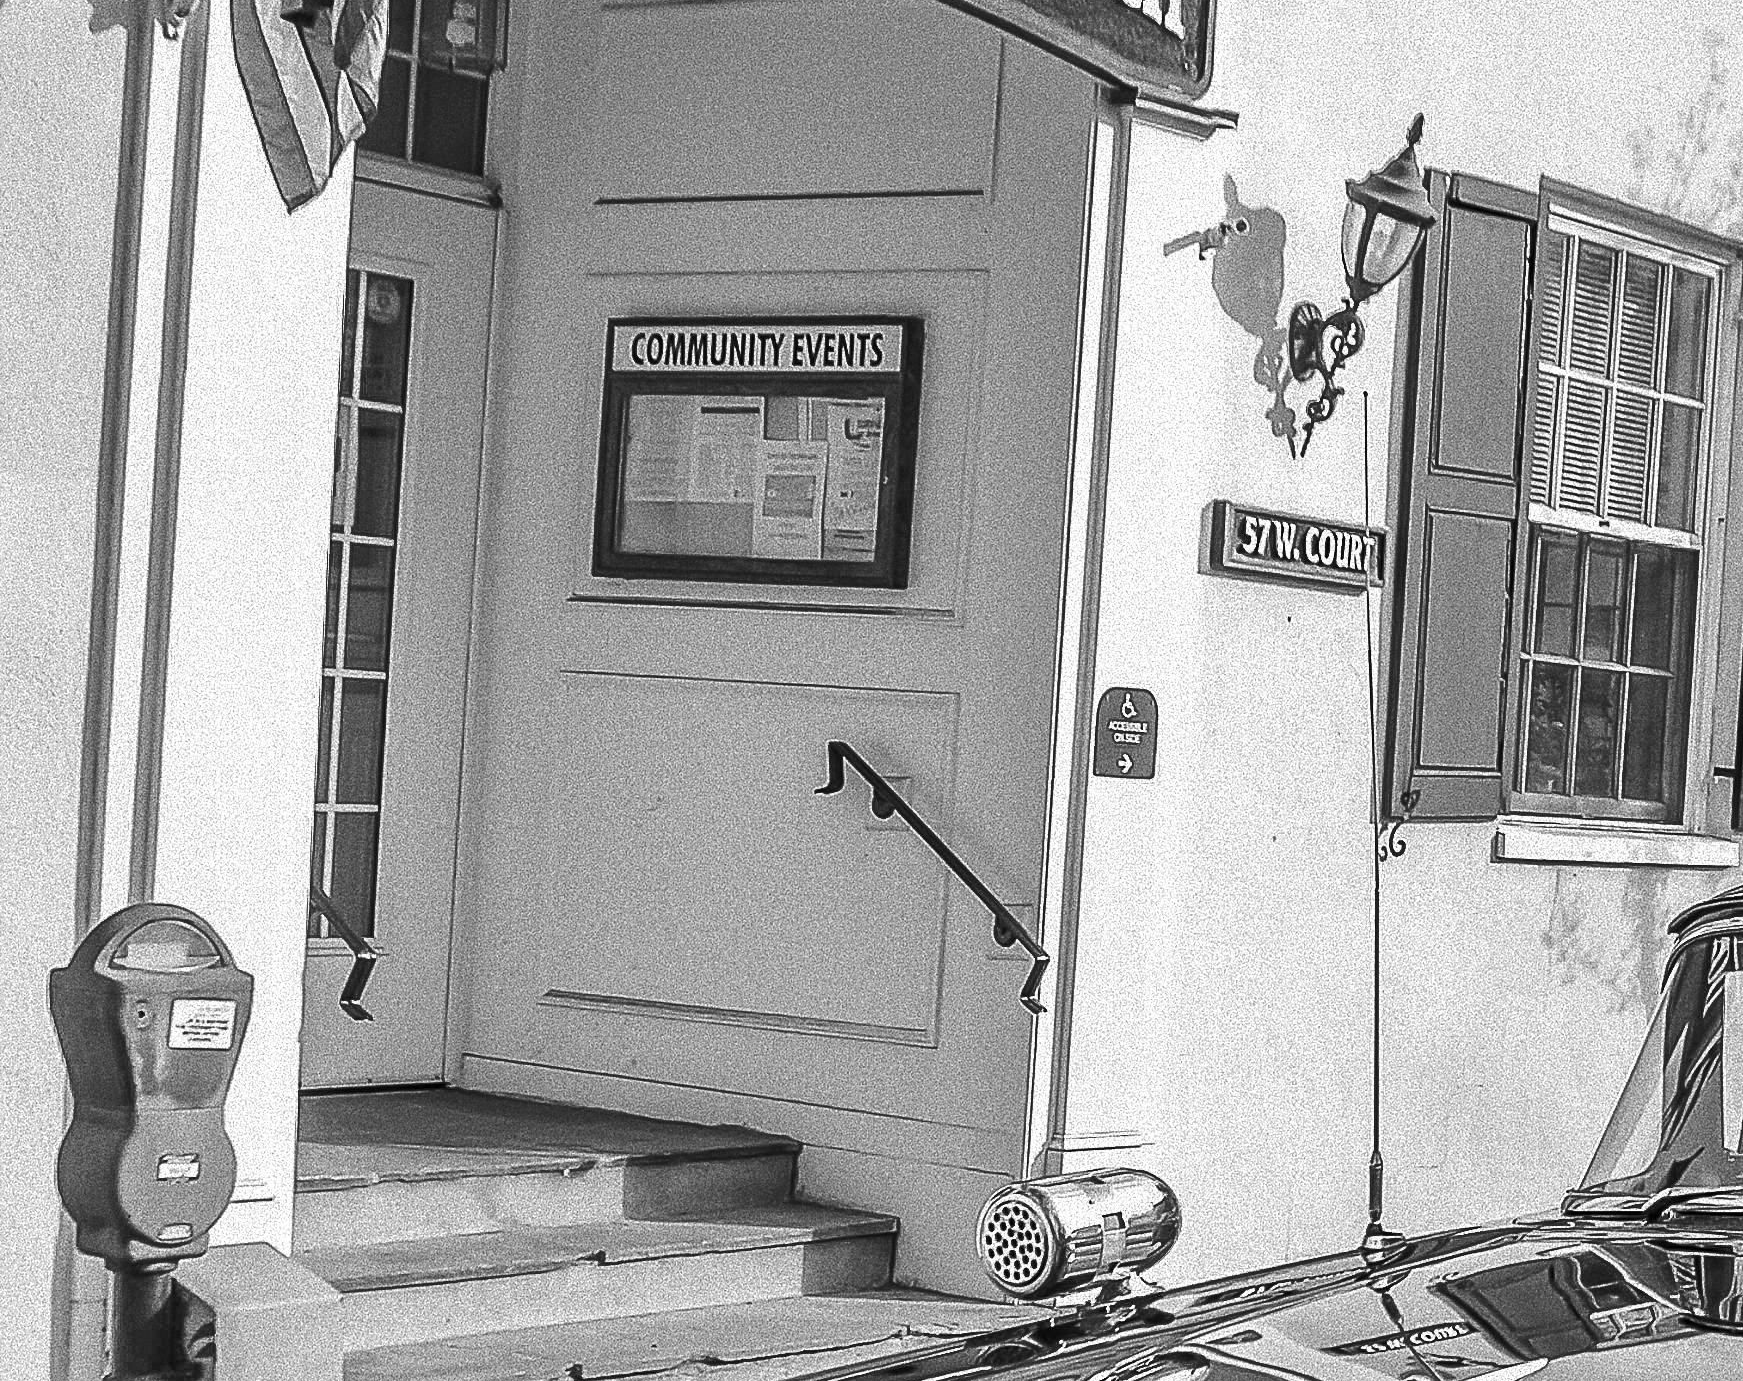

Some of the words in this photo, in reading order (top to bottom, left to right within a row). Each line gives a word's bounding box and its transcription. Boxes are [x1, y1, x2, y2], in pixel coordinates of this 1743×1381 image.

[631, 332, 785, 366] COMMUNITY
[791, 332, 884, 367] EVENTS
[1242, 515, 1271, 556] 57
[1272, 520, 1299, 561] W.
[1305, 526, 1376, 571] COURT
